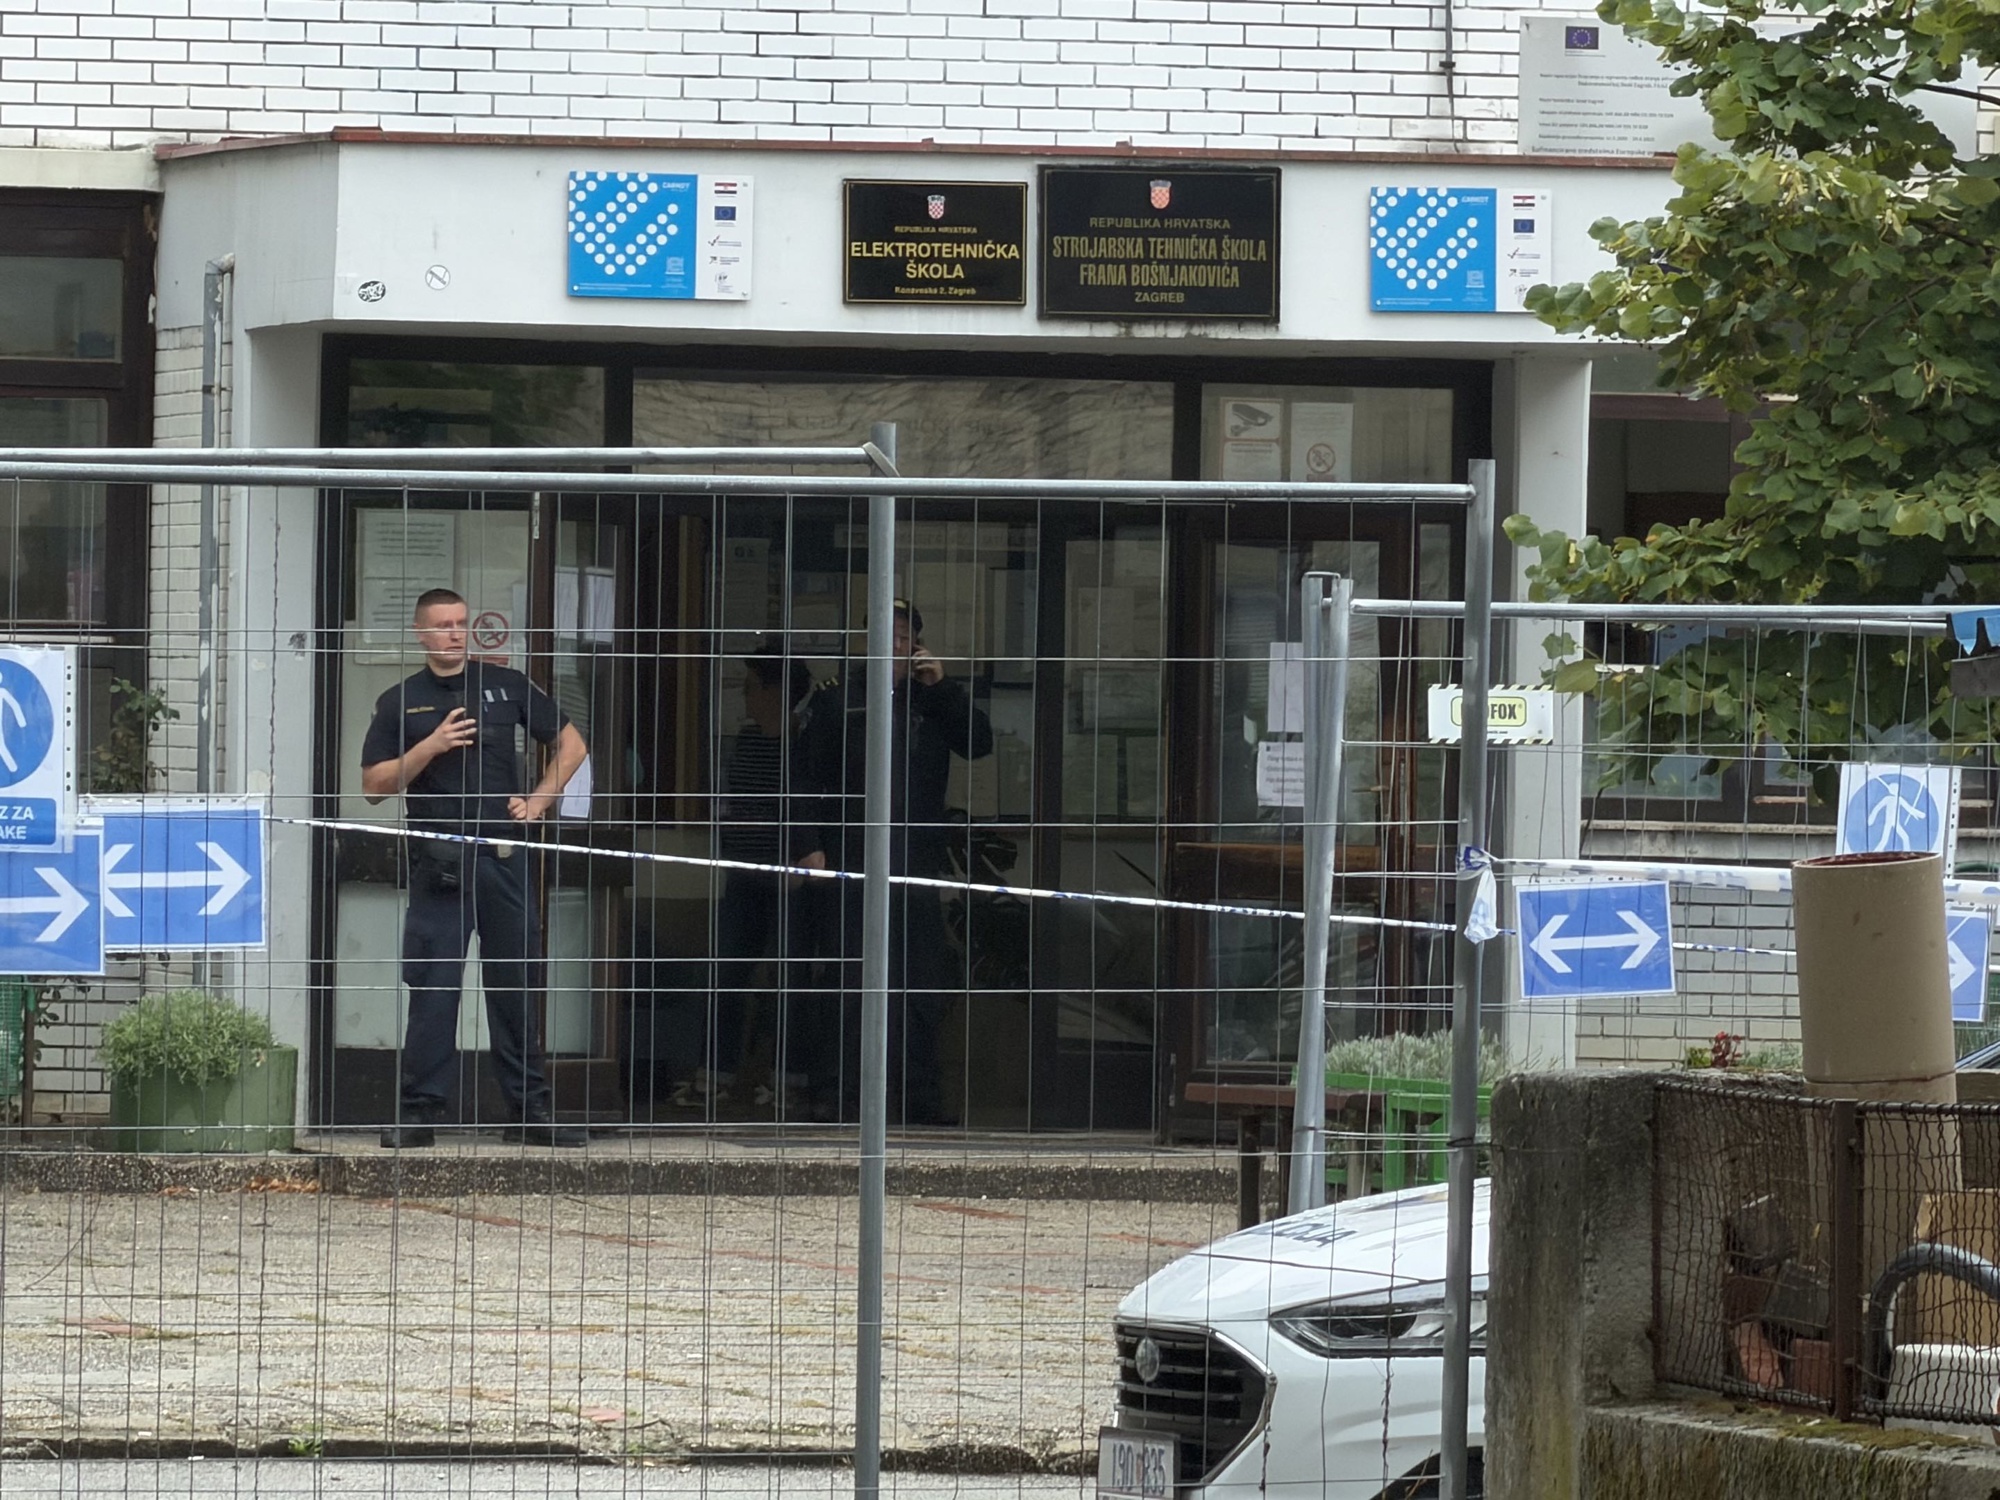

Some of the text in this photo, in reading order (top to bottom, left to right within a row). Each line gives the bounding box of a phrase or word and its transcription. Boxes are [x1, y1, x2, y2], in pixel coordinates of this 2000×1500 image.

[1089, 217, 1231, 229] REPUBLIKA HRVATSKA
[850, 240, 1020, 259] ELEKTROTEHNIČKA
[1052, 234, 1266, 261] STROJARSKA TEHNIČKA ŠKOLA
[905, 259, 965, 279] ŠKOLA
[1079, 261, 1239, 287] FRANA BOŠNJAKOVIĆA
[948, 287, 977, 296] Zagreb
[1134, 291, 1185, 303] ZAGREB
[11, 805, 35, 820] ZA
